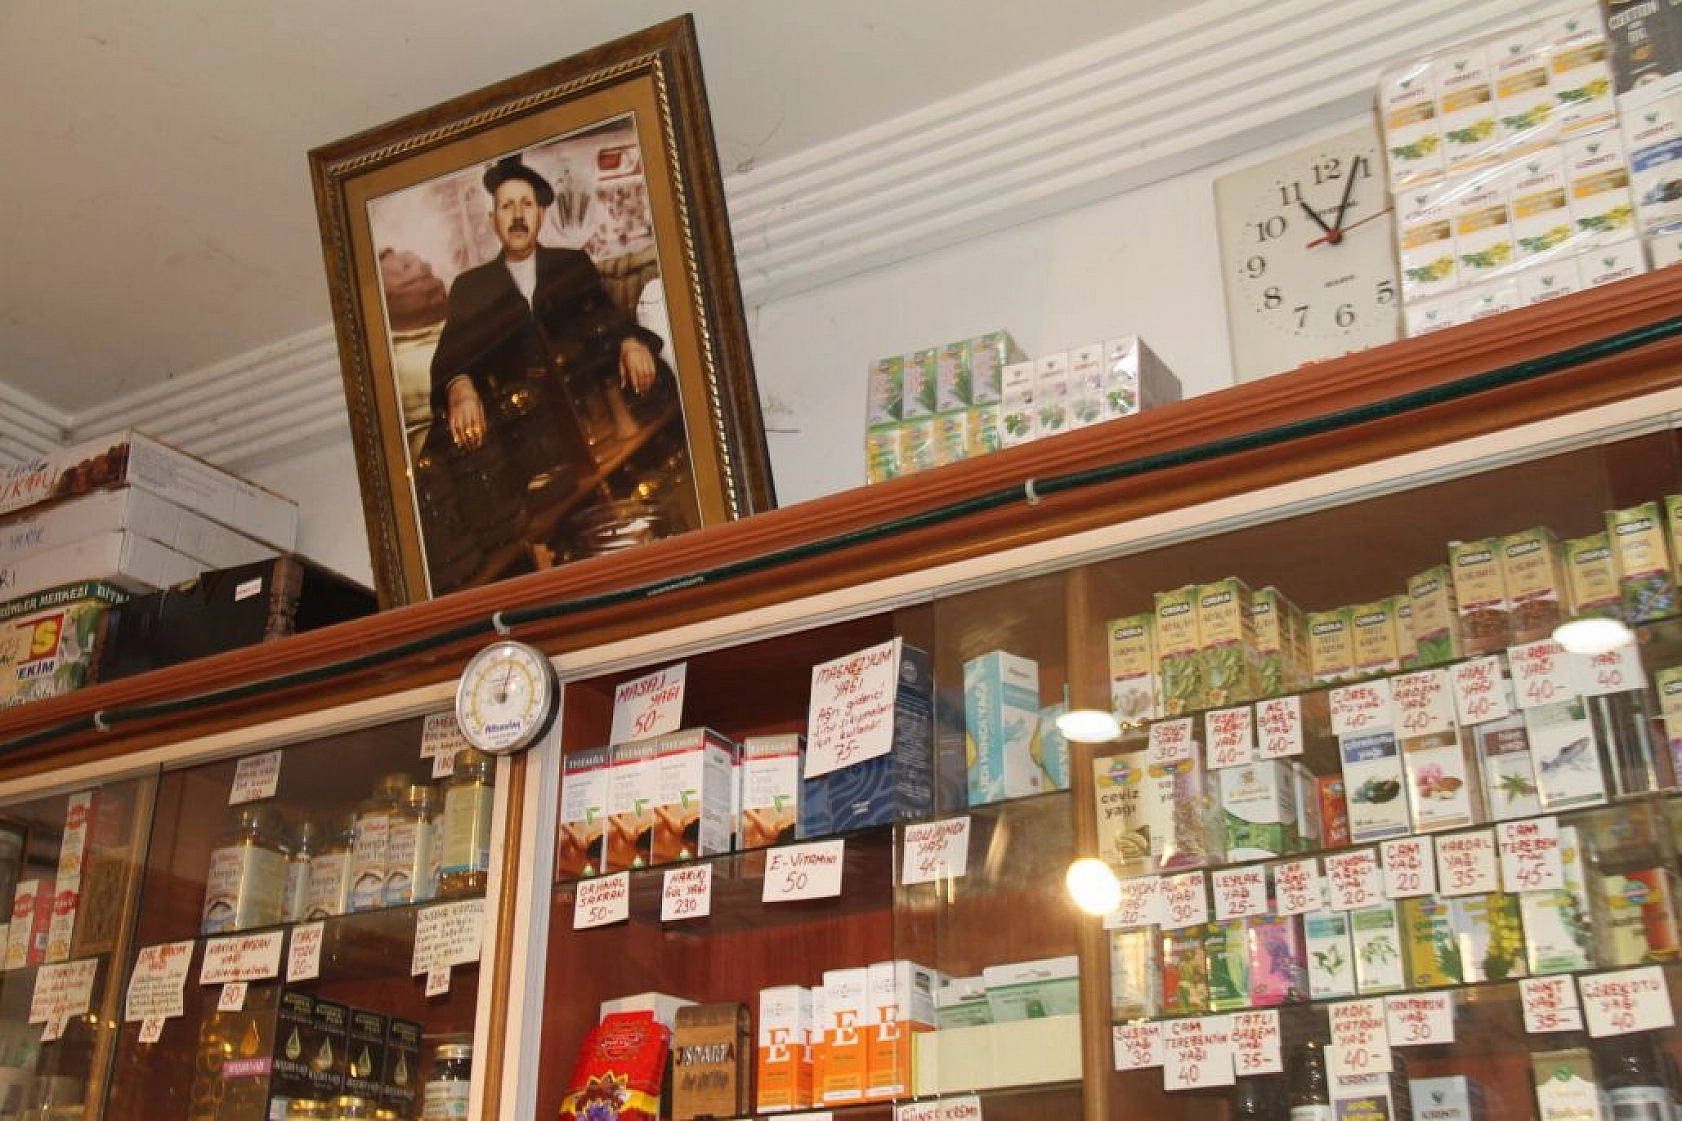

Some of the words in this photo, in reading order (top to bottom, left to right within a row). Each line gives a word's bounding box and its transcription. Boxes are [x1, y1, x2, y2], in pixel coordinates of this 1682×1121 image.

[1312, 158, 1341, 185] 12
[1359, 157, 1372, 178] 1
[1278, 182, 1303, 206] 11
[1255, 215, 1287, 243] 10
[1246, 256, 1266, 279] 9
[1263, 287, 1282, 310] 8
[1377, 280, 1394, 304] 5
[1293, 304, 1310, 328] 7
[1335, 303, 1355, 327] 6
[617, 674, 667, 702] MASAJ
[1597, 669, 1622, 686] 40
[1101, 788, 1139, 804] ceviz
[783, 871, 808, 893] 50
[1397, 873, 1420, 891] 20
[675, 898, 697, 915] 230
[1405, 1023, 1432, 1041] 30
[1132, 1051, 1152, 1066] 30
[1177, 1063, 1199, 1085] 40
